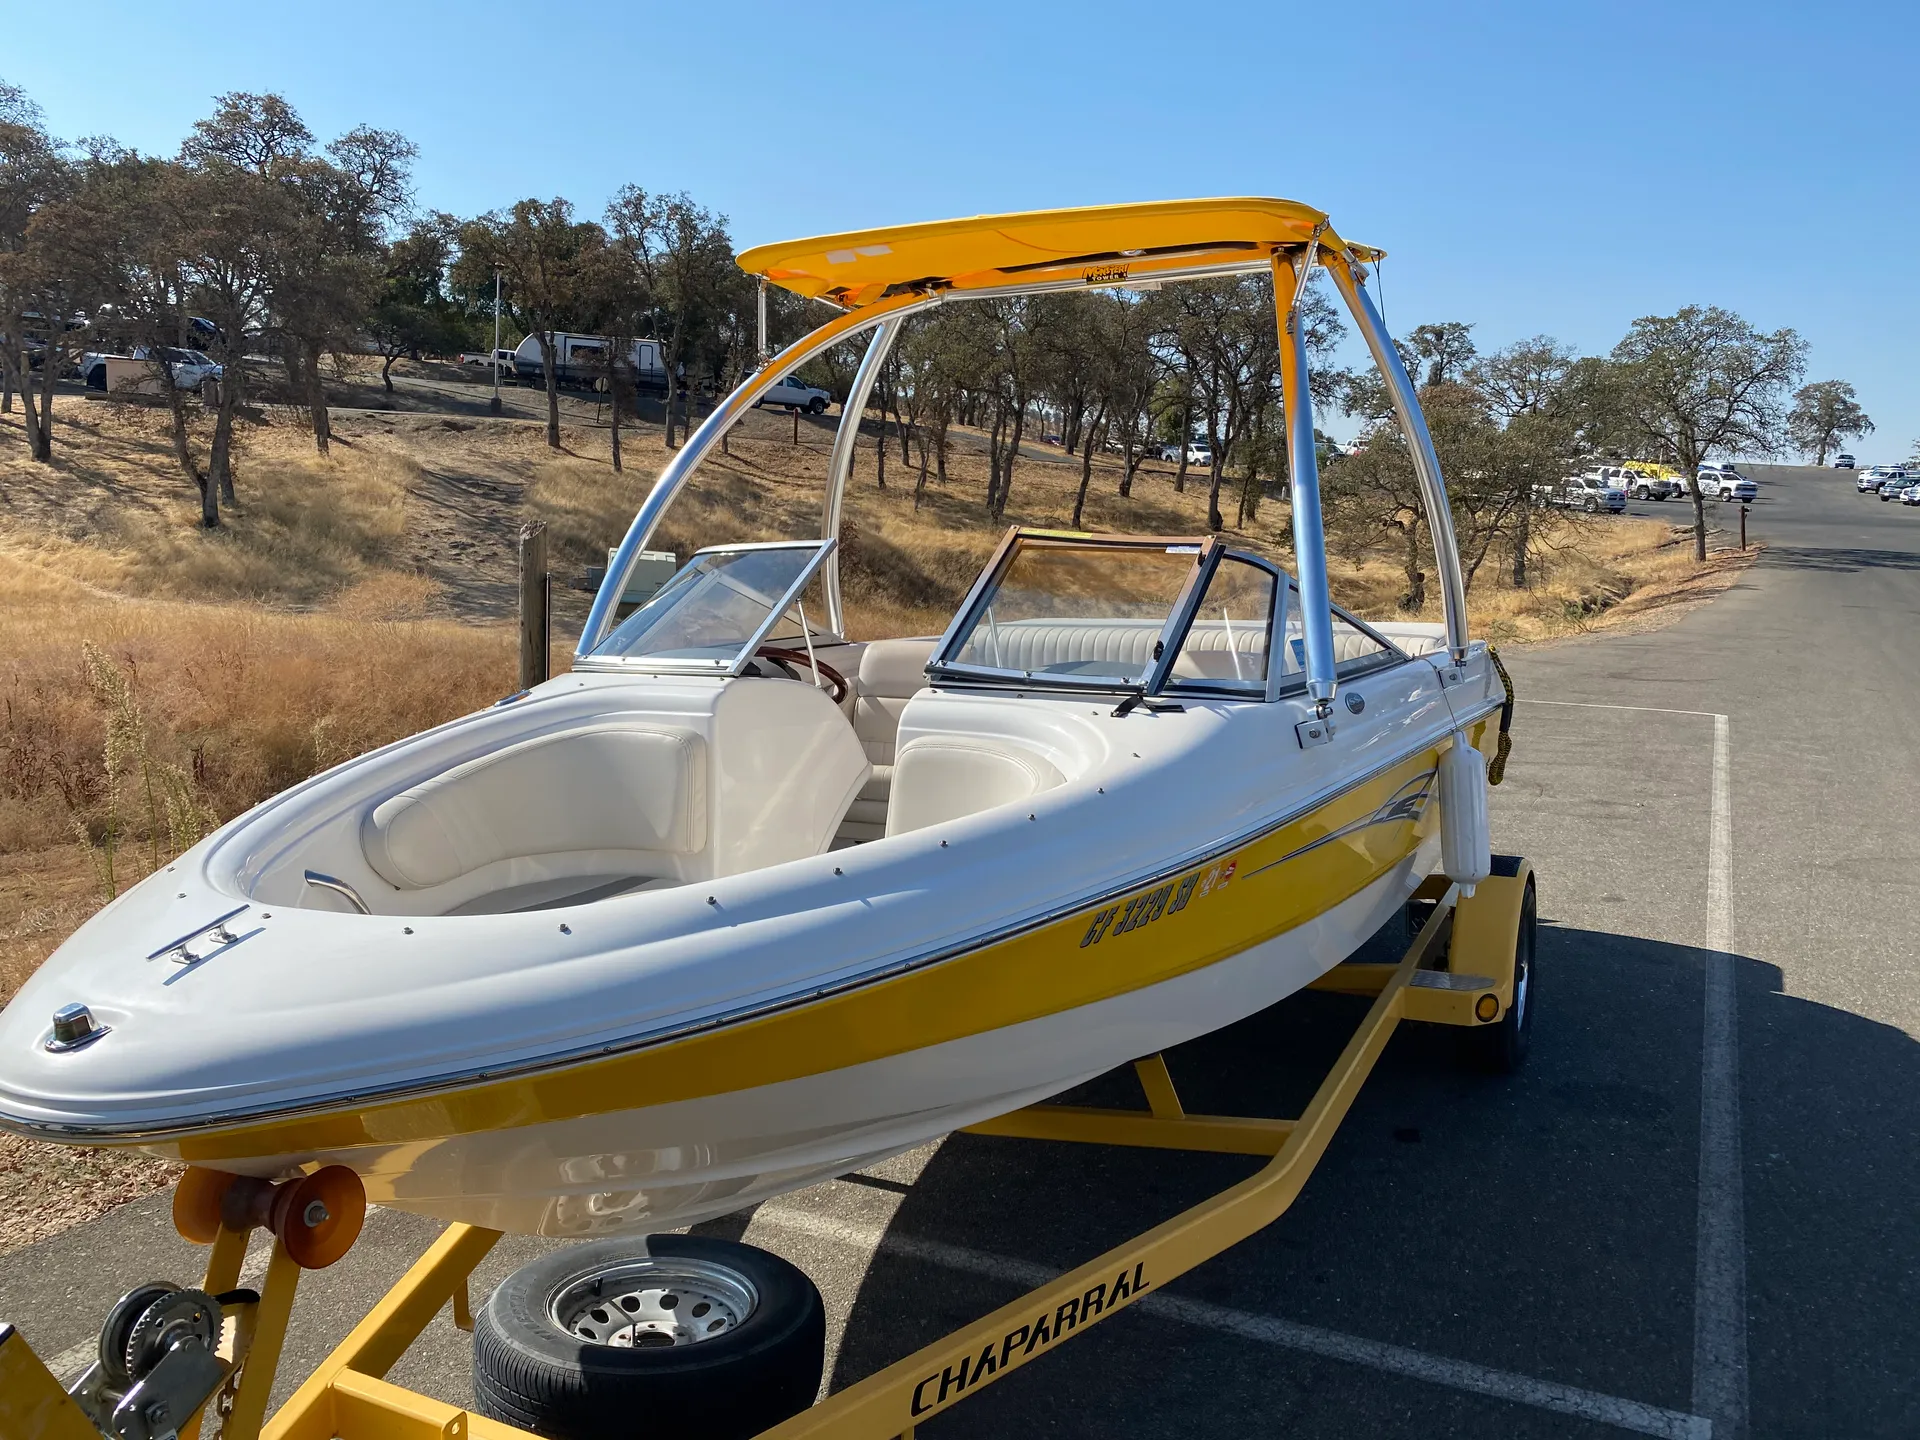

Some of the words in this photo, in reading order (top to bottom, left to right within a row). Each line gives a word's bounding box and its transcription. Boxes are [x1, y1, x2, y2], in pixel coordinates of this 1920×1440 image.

[1080, 906, 1120, 948] CF
[1113, 884, 1174, 936] 3229
[911, 1262, 1150, 1418] CHAPARRAL
